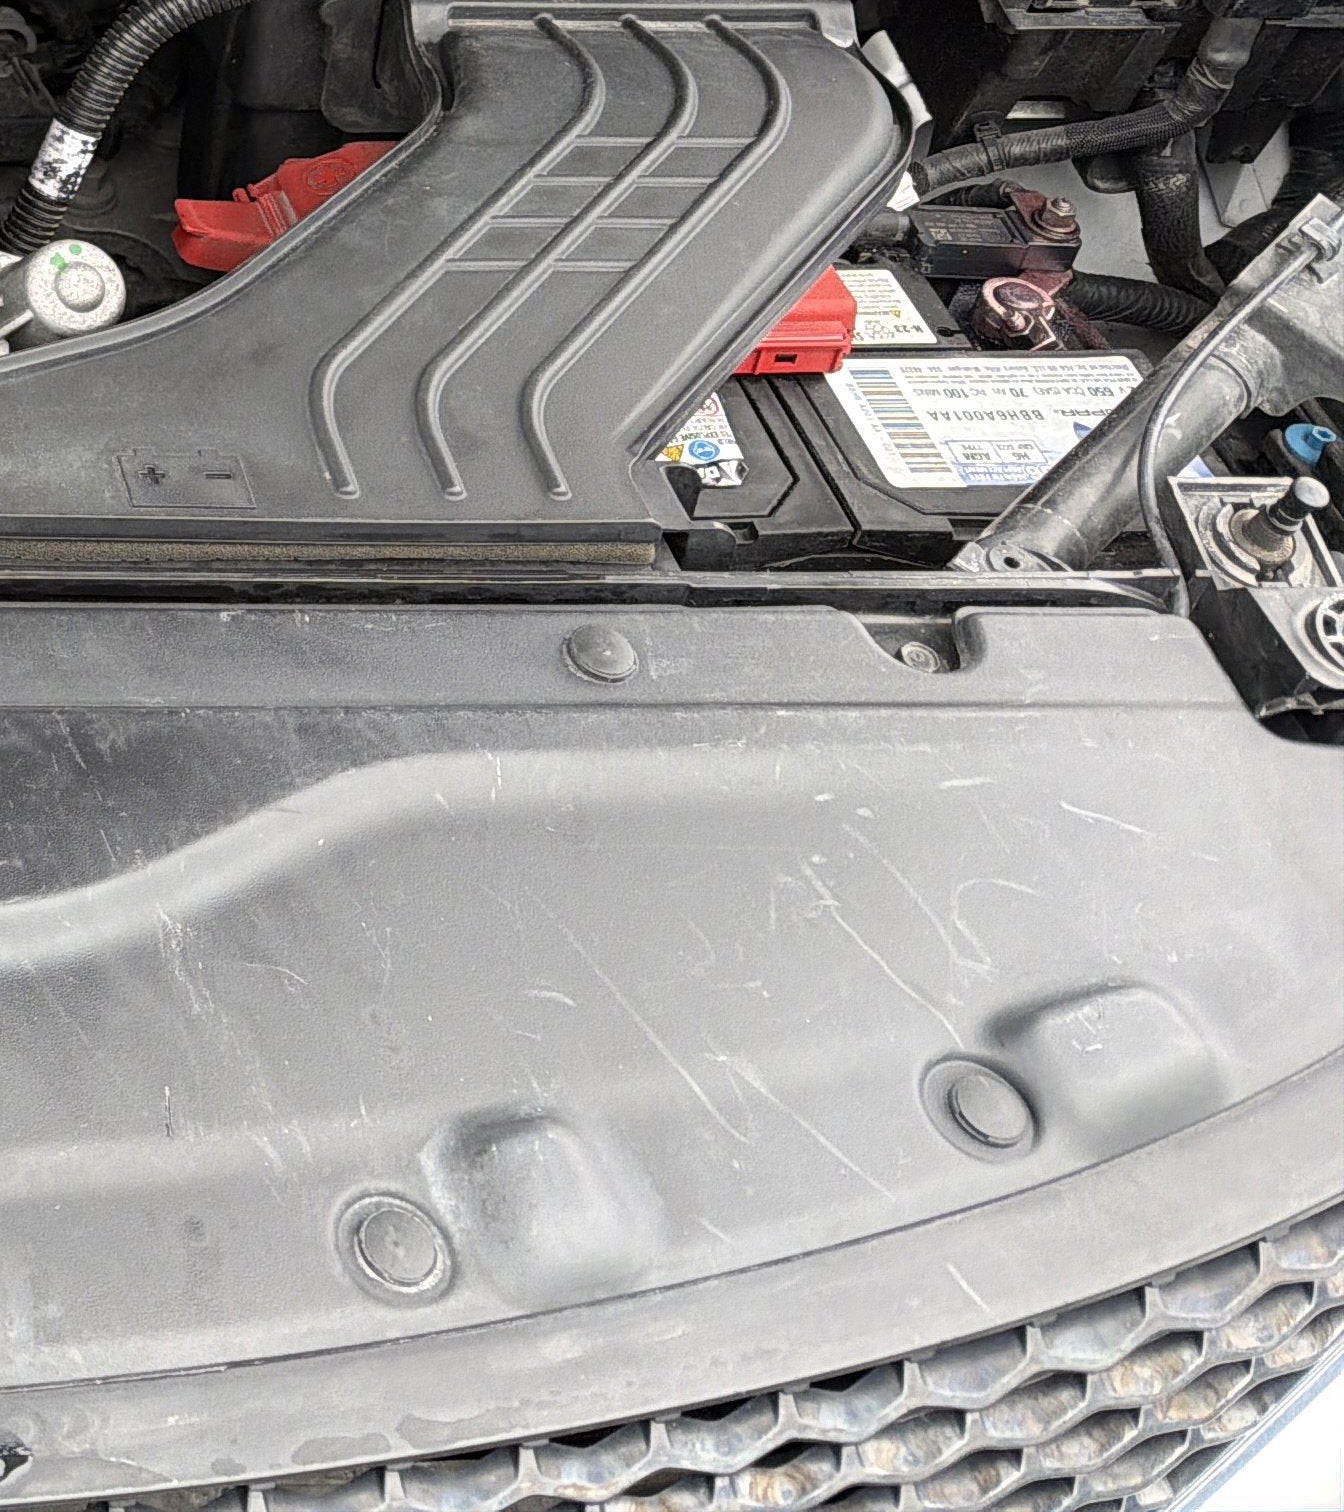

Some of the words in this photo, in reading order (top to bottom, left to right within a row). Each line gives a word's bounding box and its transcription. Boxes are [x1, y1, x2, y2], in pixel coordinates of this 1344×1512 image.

[943, 388, 969, 399] 100
[1009, 387, 1029, 398] 70
[1087, 386, 1114, 397] 650
